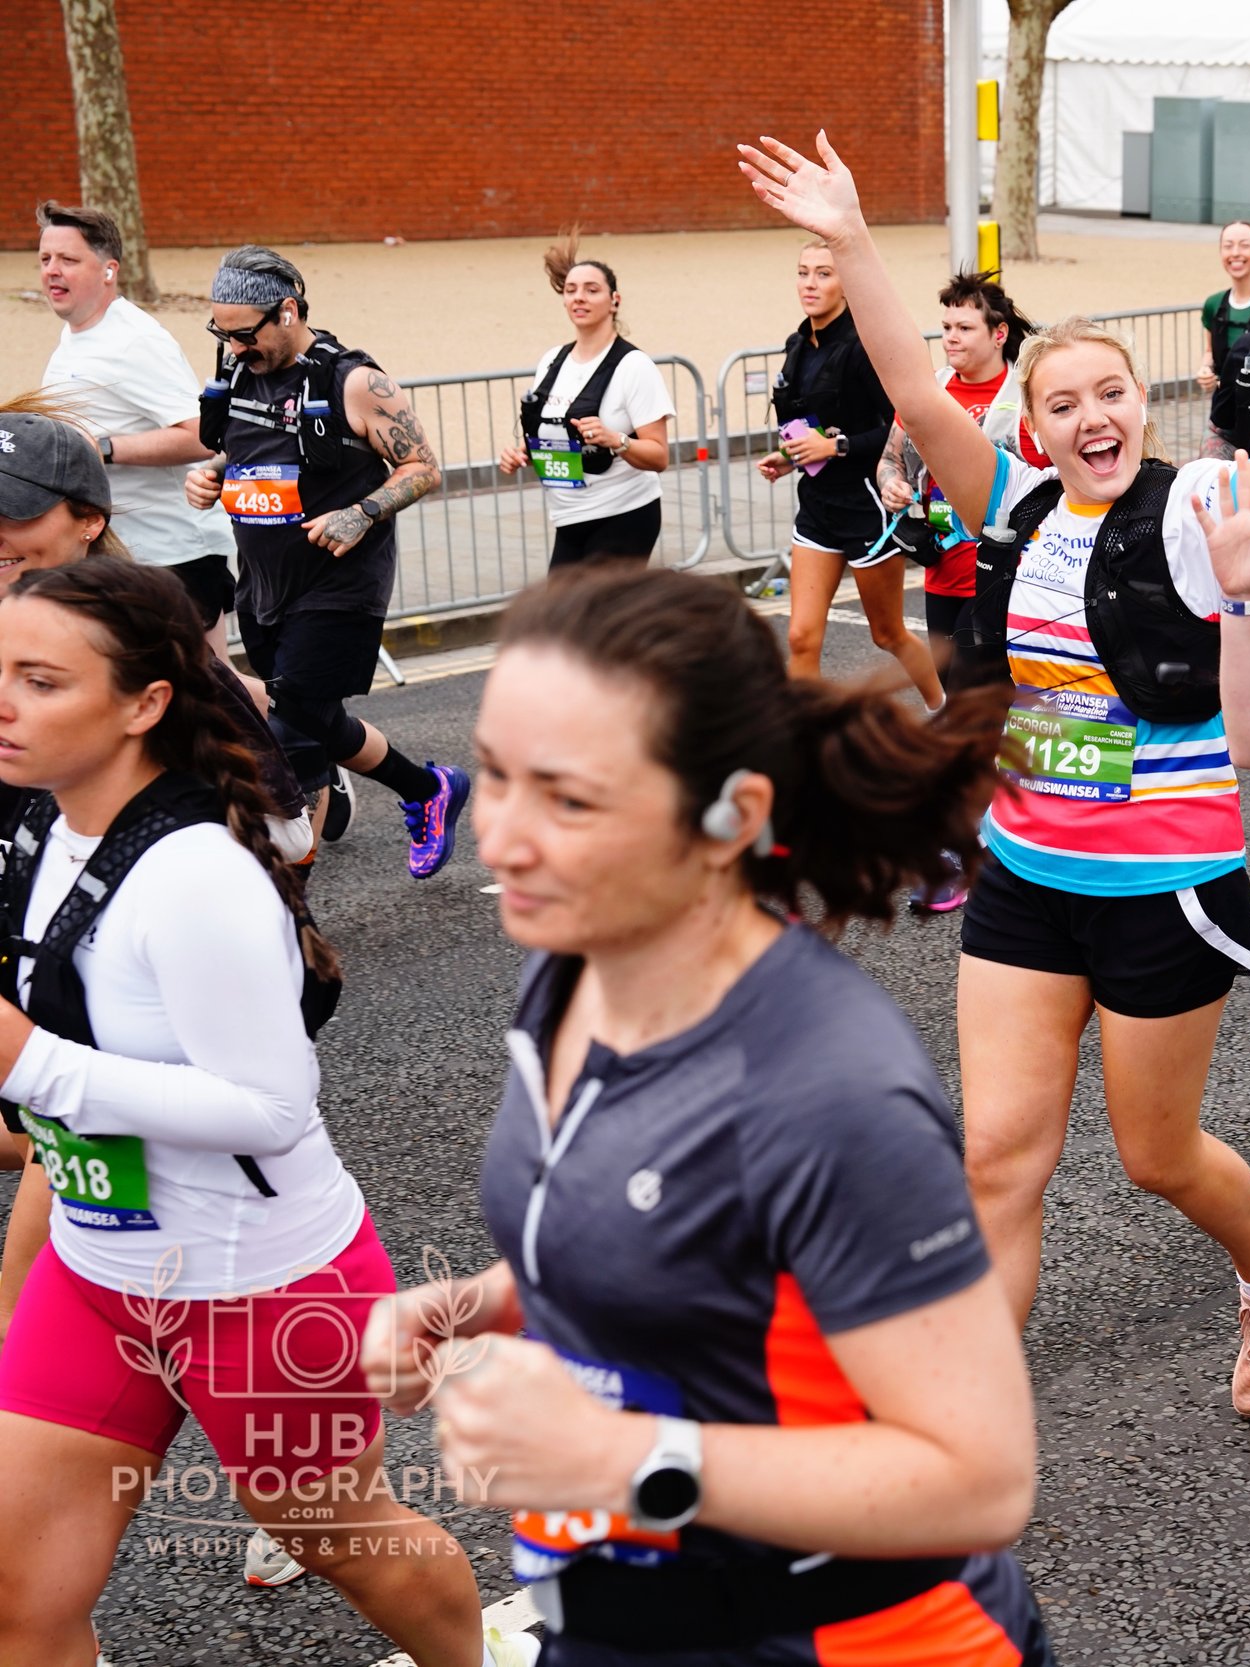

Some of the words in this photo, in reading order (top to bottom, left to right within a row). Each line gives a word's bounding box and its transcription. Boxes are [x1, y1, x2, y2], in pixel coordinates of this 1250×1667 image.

[545, 461, 570, 477] 555
[235, 493, 283, 512] 4493
[1060, 692, 1109, 709] SWANSEA
[1009, 715, 1062, 737] GEORGIA
[1110, 730, 1133, 739] CANCER
[1083, 735, 1113, 744] RESEARCH
[1024, 736, 1101, 776] 1129
[1019, 778, 1100, 799] #RUNSWANSEA
